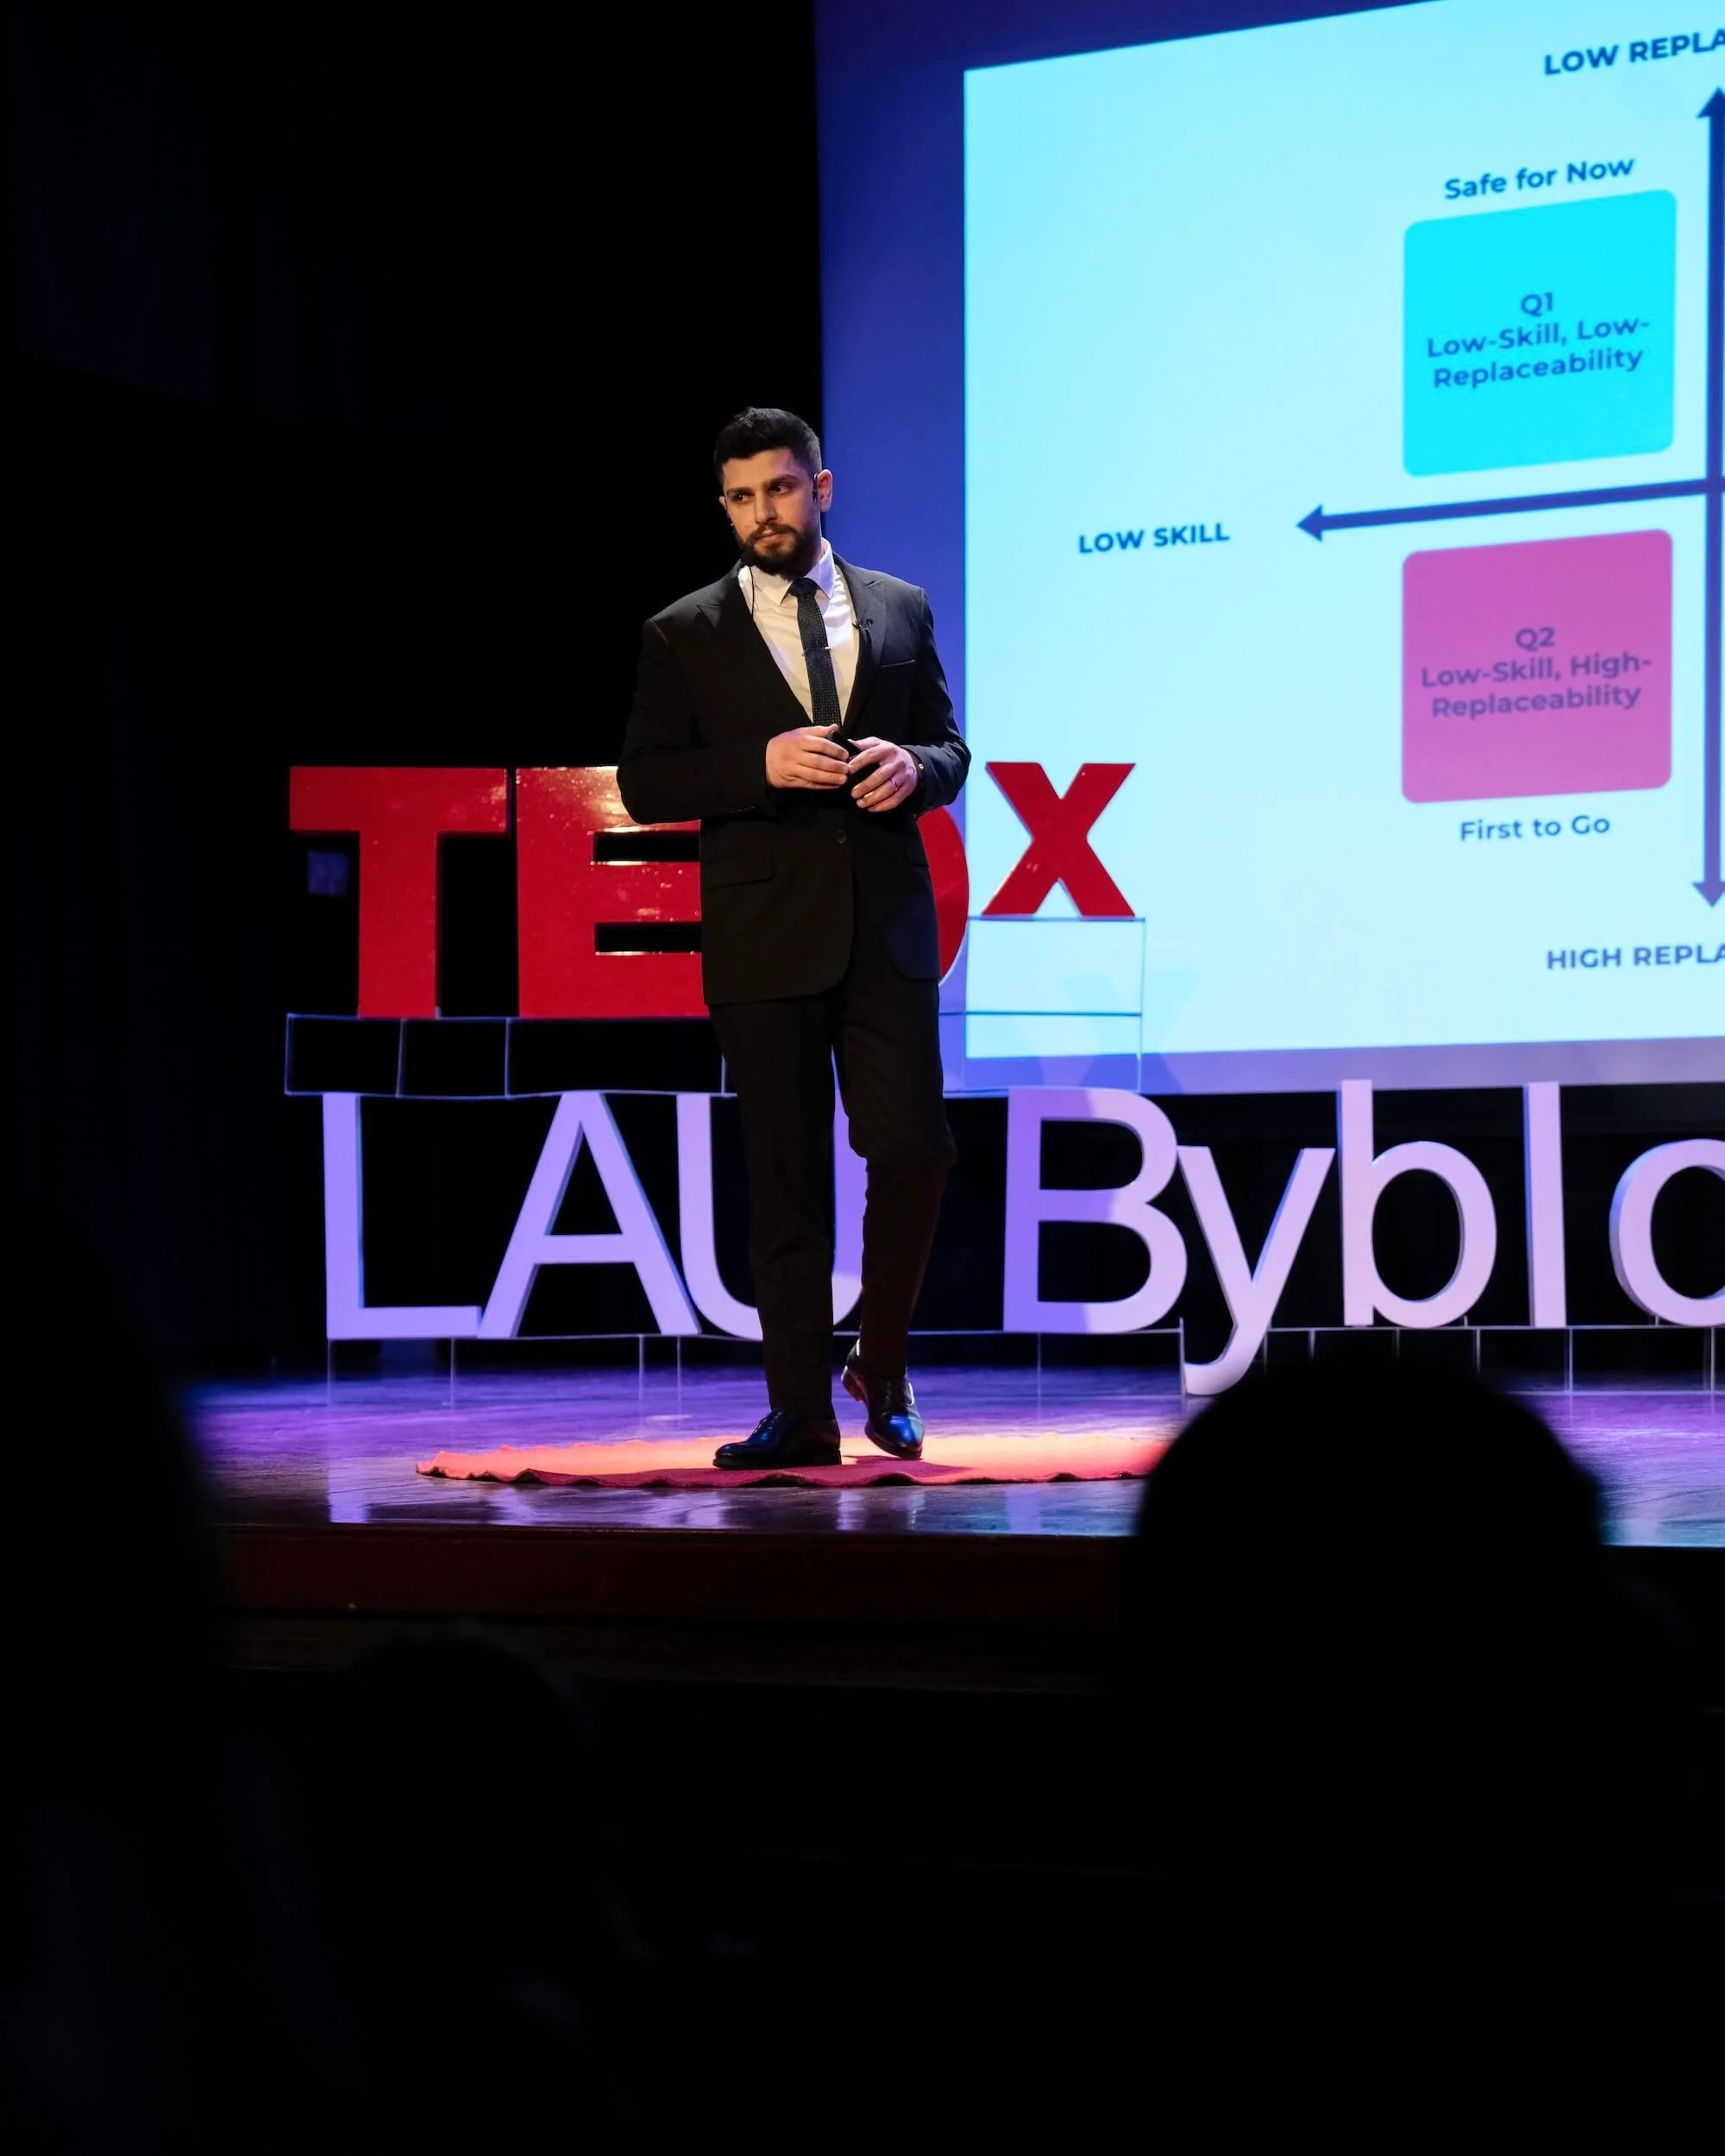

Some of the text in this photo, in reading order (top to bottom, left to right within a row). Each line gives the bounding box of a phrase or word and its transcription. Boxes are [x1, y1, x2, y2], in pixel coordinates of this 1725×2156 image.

[1544, 45, 1619, 75] LOW
[1444, 159, 1634, 199] Safe for Now
[1520, 291, 1554, 317] Q1
[1427, 317, 1650, 358] Low-Skill, Low-
[1433, 348, 1643, 389] Replaceability
[1078, 523, 1230, 554] LOW SKILL
[1515, 626, 1555, 652] Q2
[1421, 651, 1653, 688] Low-Skill, High-
[1431, 685, 1642, 720] Replaceability
[1460, 814, 1612, 842] First to Go
[1547, 948, 1622, 969] HIGH
[322, 1090, 868, 1342] LAU
